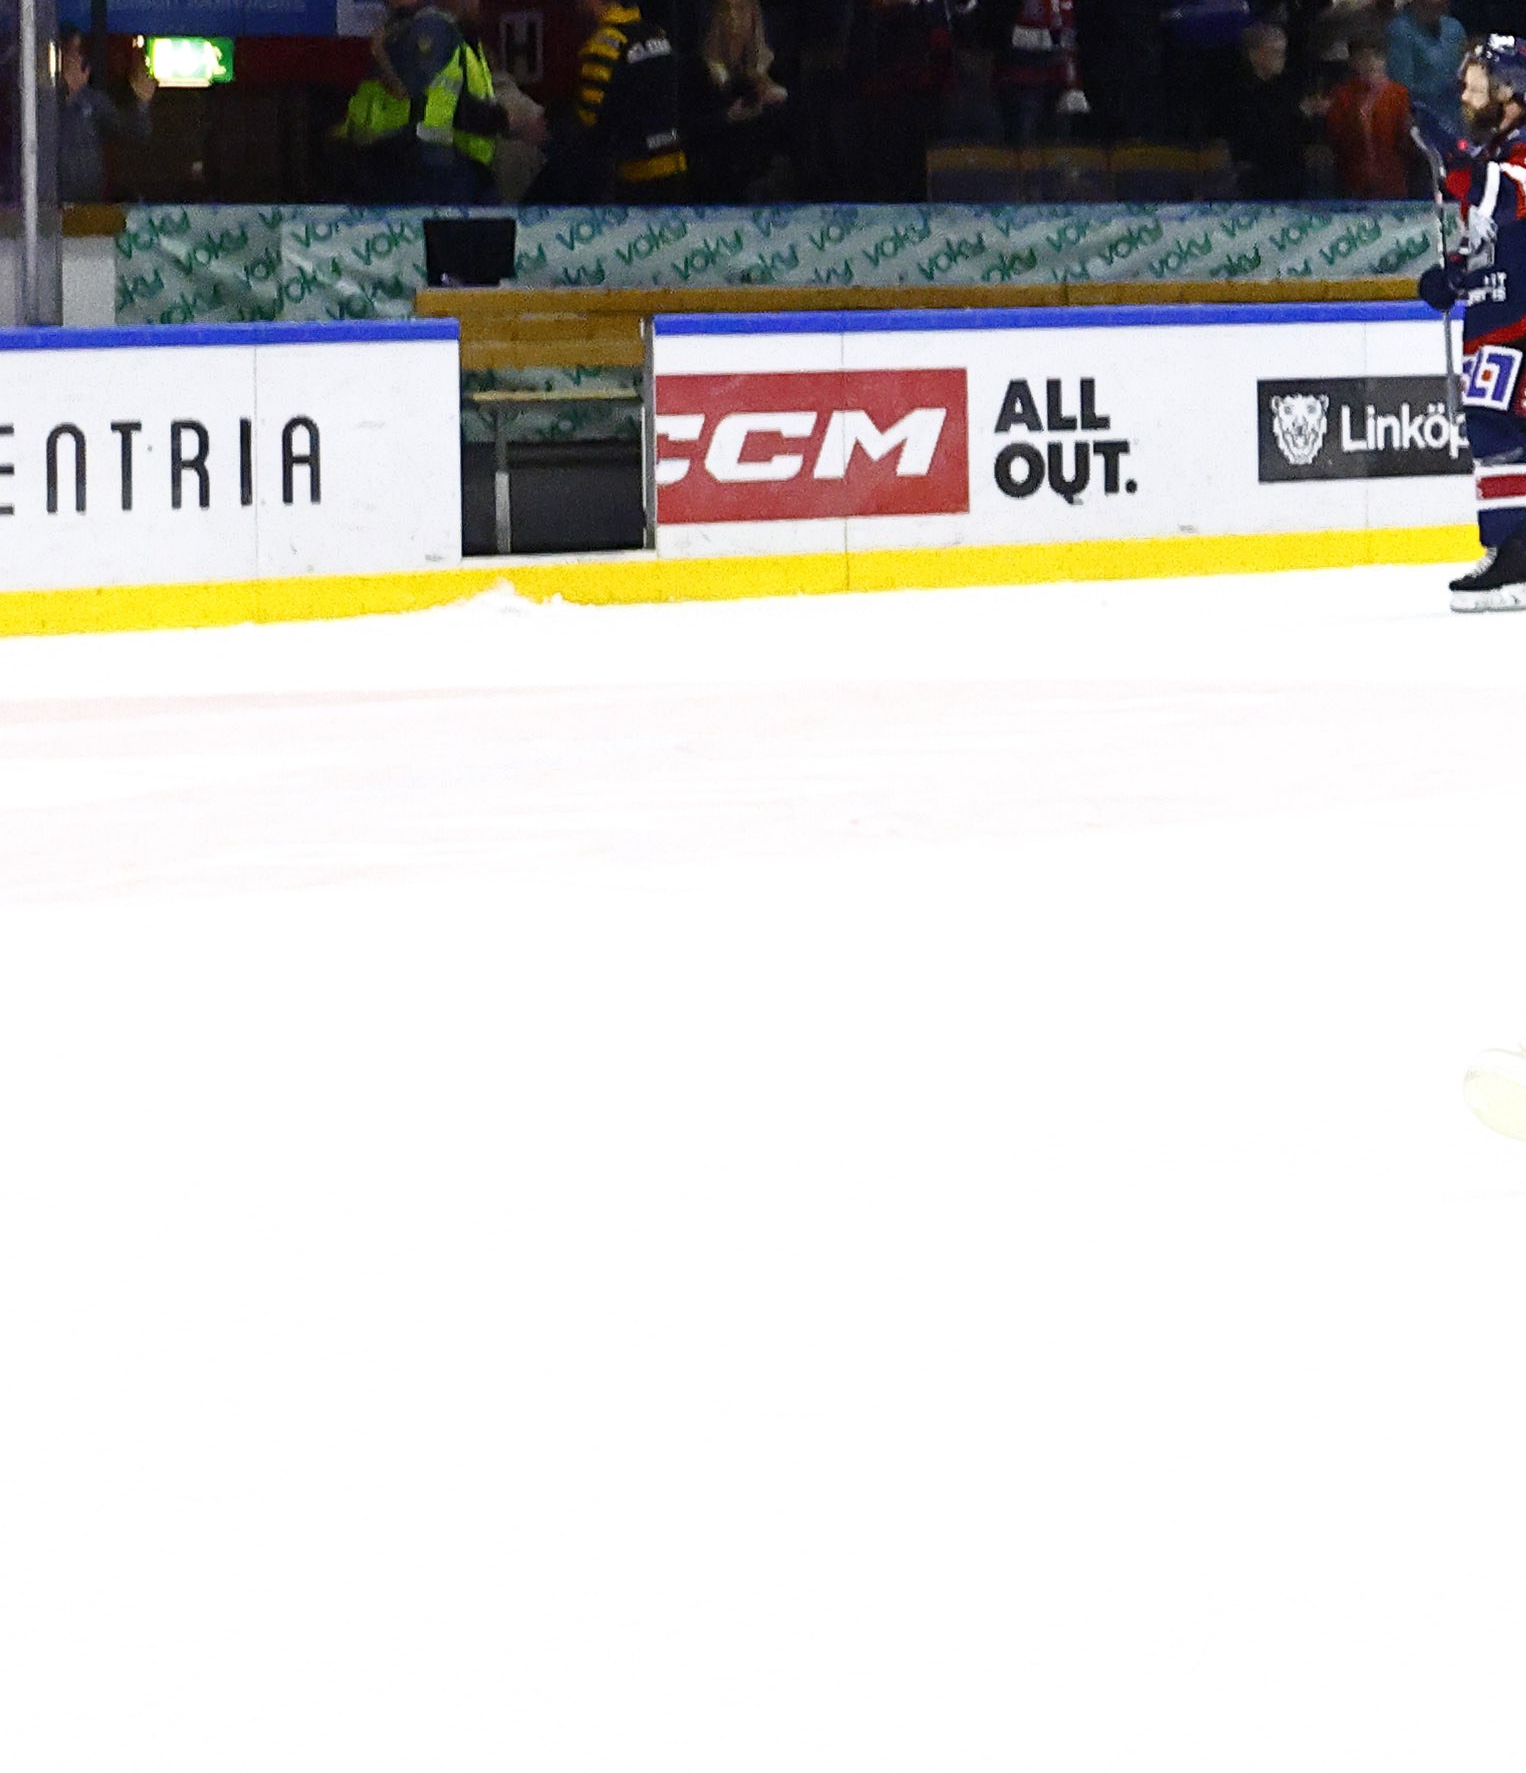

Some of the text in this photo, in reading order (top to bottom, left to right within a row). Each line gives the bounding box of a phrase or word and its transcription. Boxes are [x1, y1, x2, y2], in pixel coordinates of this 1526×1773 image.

[995, 377, 1111, 434] ALL
[1340, 402, 1470, 460] Linköp
[0, 415, 322, 518] ENTRIA
[994, 441, 1138, 503] OUT.
